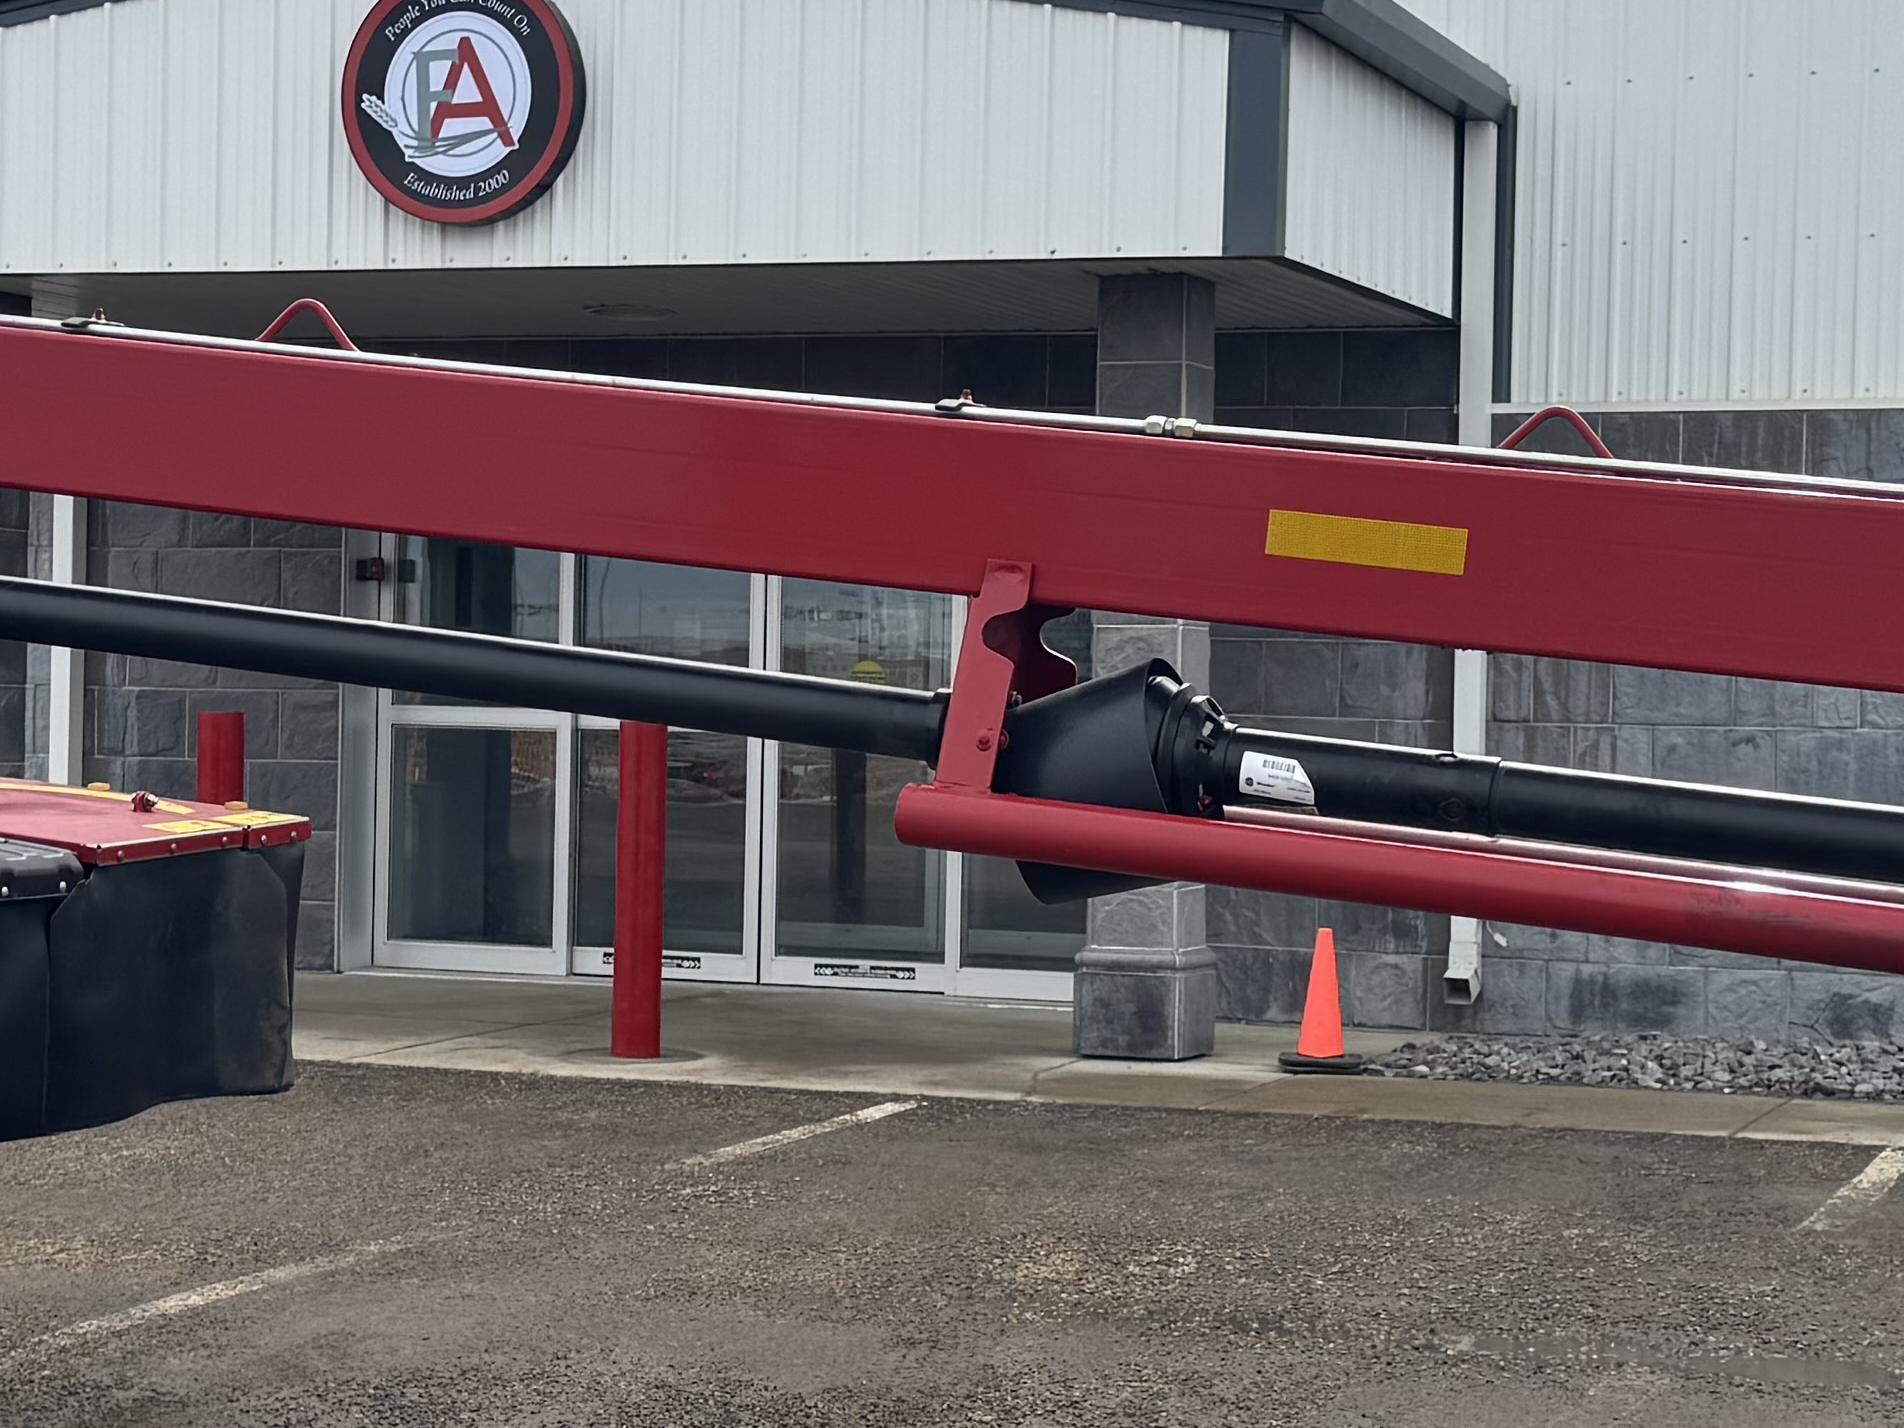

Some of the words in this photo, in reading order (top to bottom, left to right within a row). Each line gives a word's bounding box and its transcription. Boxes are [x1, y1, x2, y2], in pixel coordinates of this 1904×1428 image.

[385, 5, 421, 42] People
[514, 14, 531, 36] On
[403, 172, 474, 200] Established
[477, 170, 510, 197] 2000
